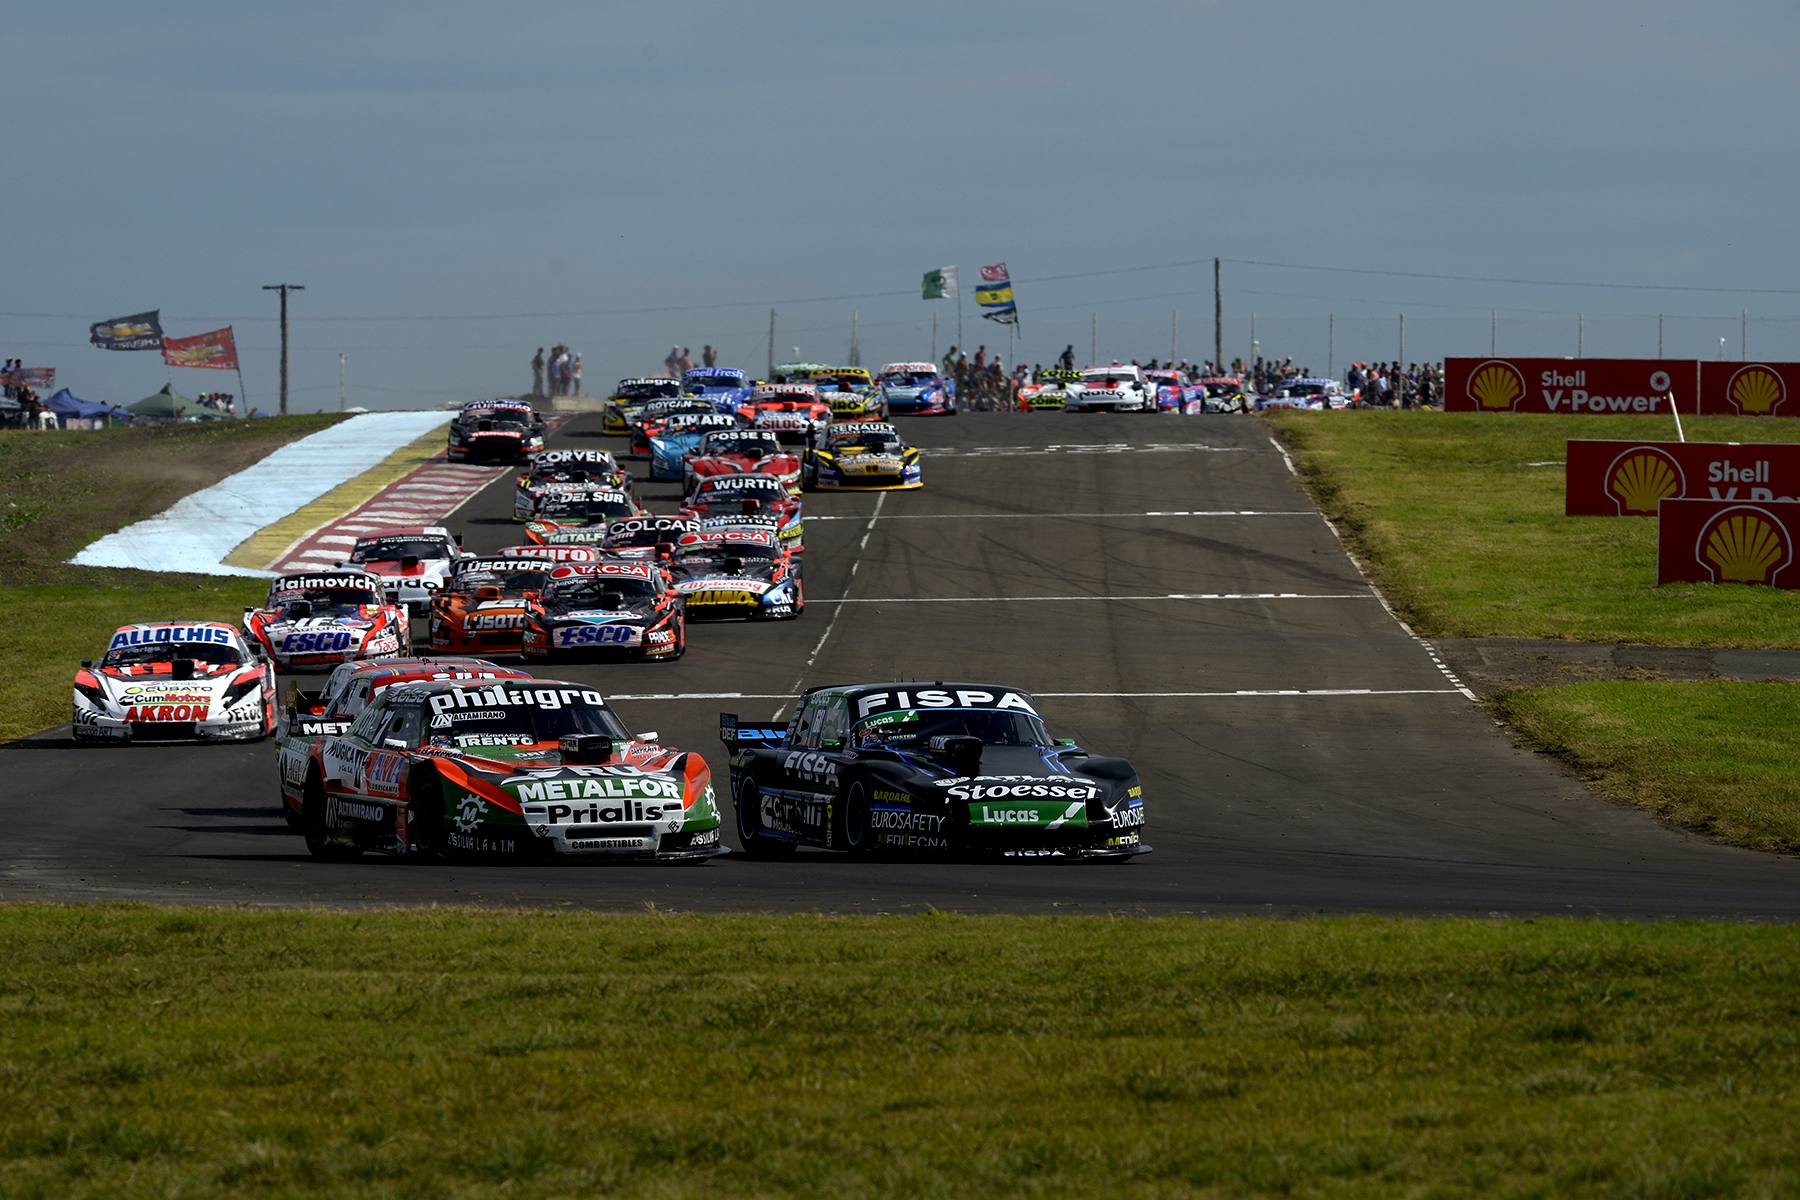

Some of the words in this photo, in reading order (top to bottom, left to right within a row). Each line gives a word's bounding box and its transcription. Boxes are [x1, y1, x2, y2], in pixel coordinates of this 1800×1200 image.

[1541, 370, 1586, 387] Shell
[1542, 389, 1661, 412] V-Power
[535, 451, 609, 464] CORVEN
[1708, 460, 1769, 483] Shell
[592, 492, 624, 503] SUR
[609, 519, 701, 536] COLCAR
[704, 531, 767, 541] TACSA
[577, 564, 646, 577] TACSA
[272, 576, 376, 593] Haimovich
[281, 632, 351, 653] ESCO
[561, 626, 632, 646] ESCO
[430, 684, 604, 714] philagro
[858, 690, 1037, 718] FISPA
[122, 704, 209, 725] AKRON
[453, 711, 506, 721] ALTAMIRANO
[864, 716, 894, 729] Lucas
[454, 736, 534, 747] TRENTO
[516, 778, 681, 802] METALFOR
[947, 784, 1096, 801] Stoessel
[547, 800, 663, 824] Prialis
[982, 806, 1040, 823] Lucas
[871, 811, 947, 832] EUROSAFETY
[571, 839, 643, 850] COMBUSTIBLES
